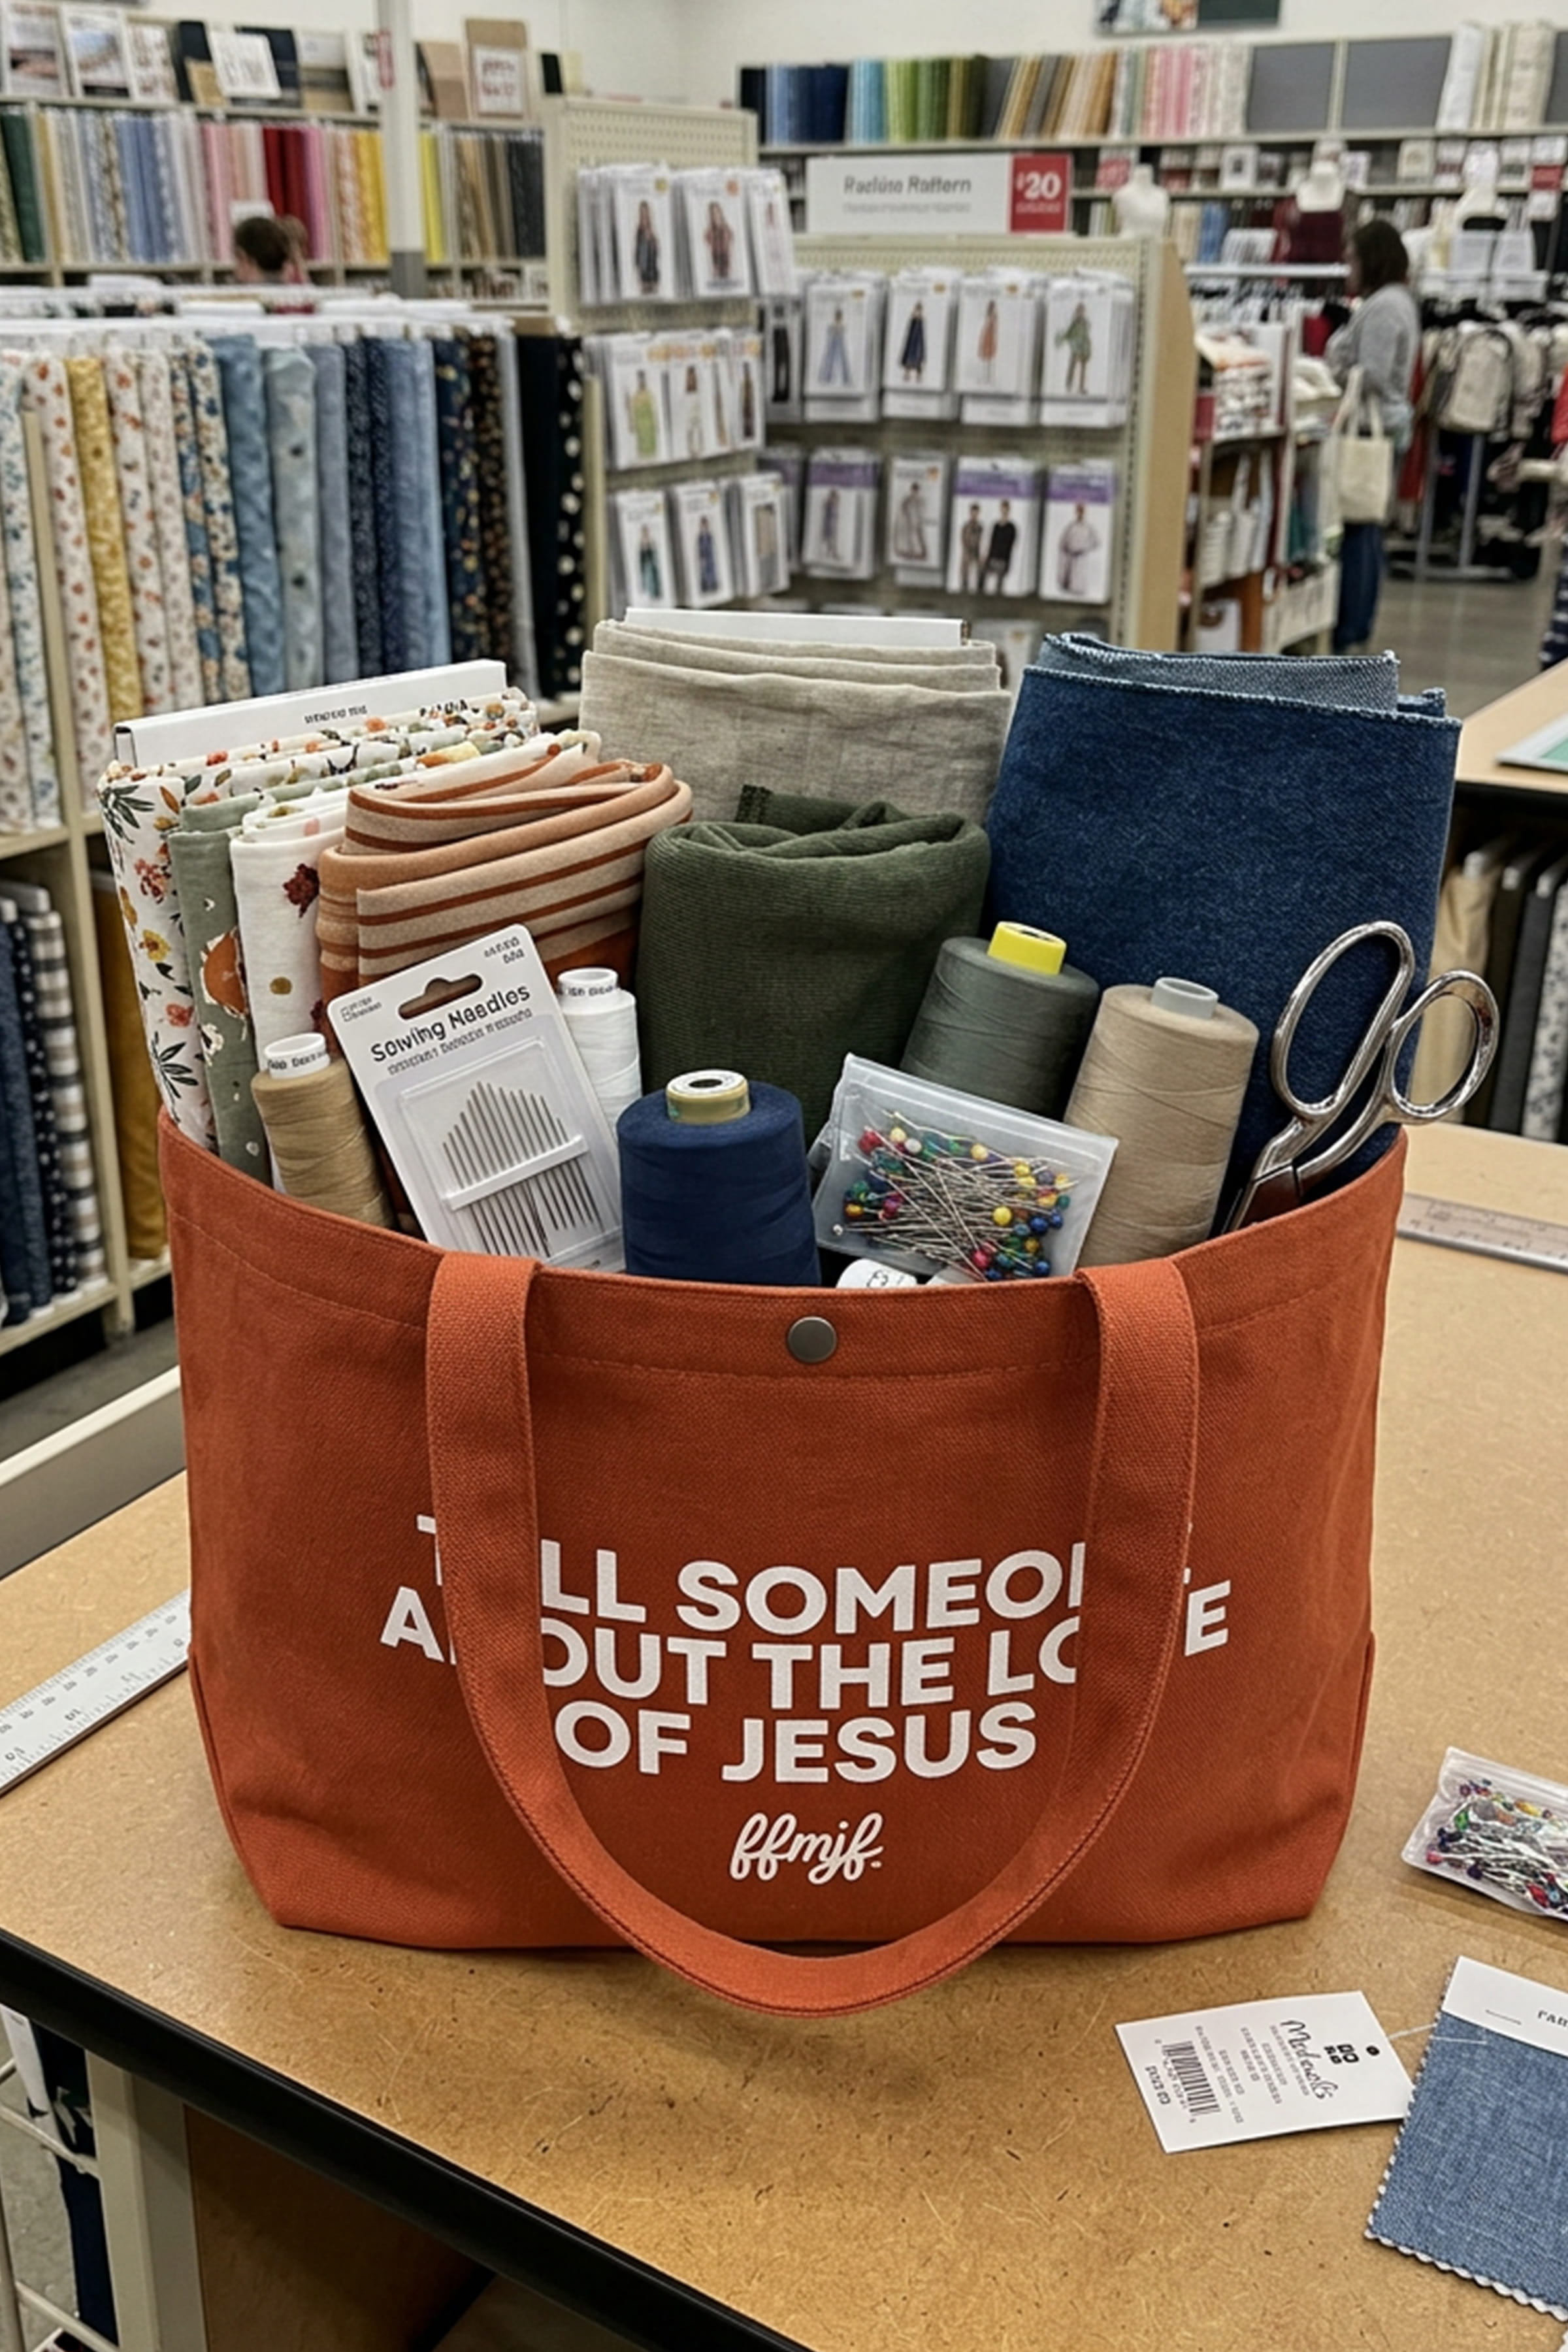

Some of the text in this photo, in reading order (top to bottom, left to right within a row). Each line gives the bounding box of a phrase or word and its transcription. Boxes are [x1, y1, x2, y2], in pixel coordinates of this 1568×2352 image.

[380, 1586, 727, 1705] AOUT
[752, 1637, 955, 1709] THE
[555, 1701, 1036, 1783] OF JESUS
